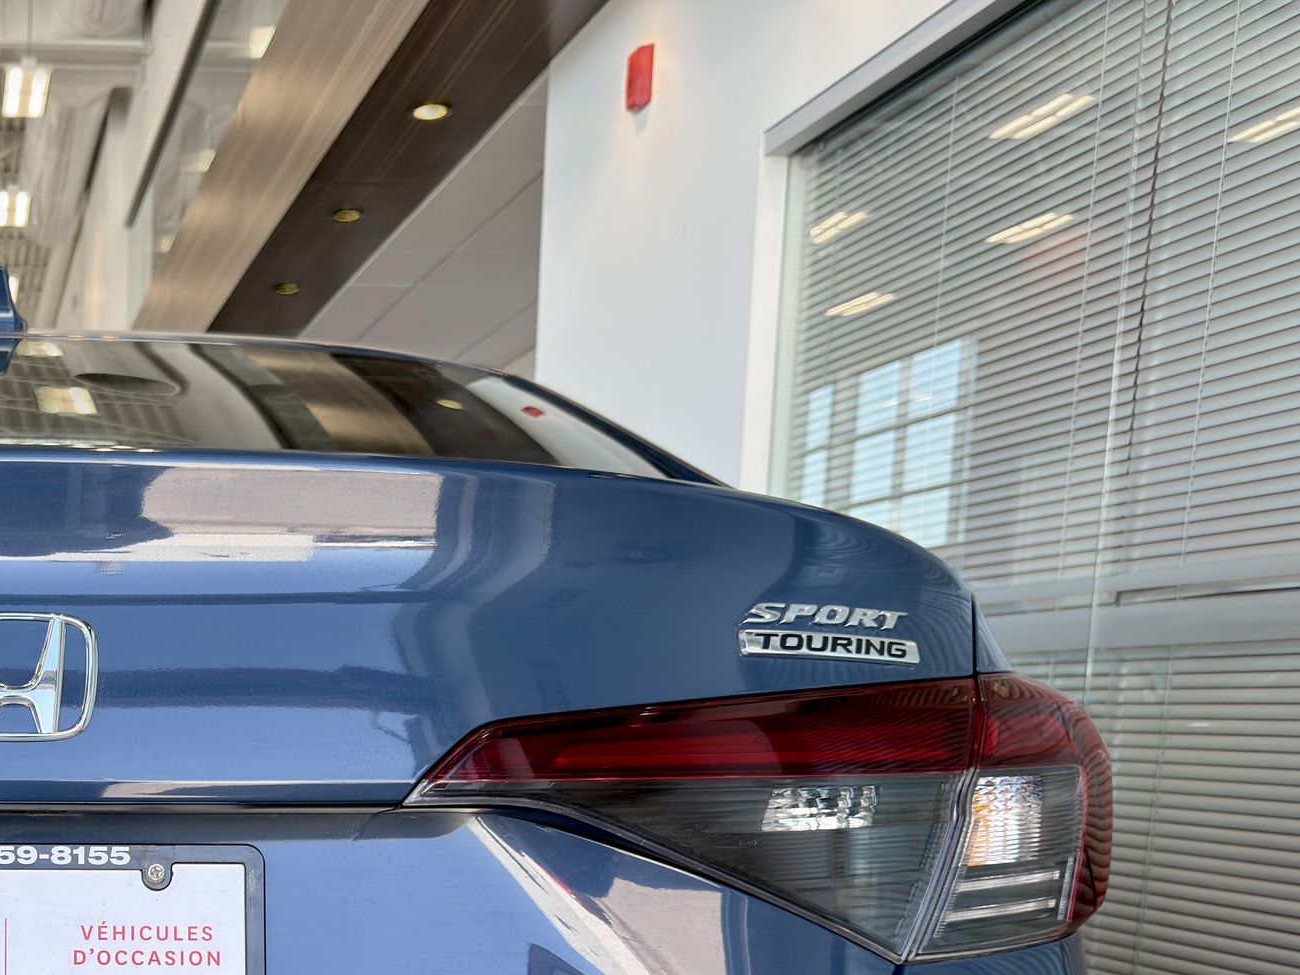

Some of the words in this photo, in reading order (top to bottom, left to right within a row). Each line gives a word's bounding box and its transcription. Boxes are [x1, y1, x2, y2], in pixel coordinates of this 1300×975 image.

[738, 601, 909, 631] SPORT
[754, 632, 908, 659] TOURING
[80, 920, 214, 942] VÉHICULES
